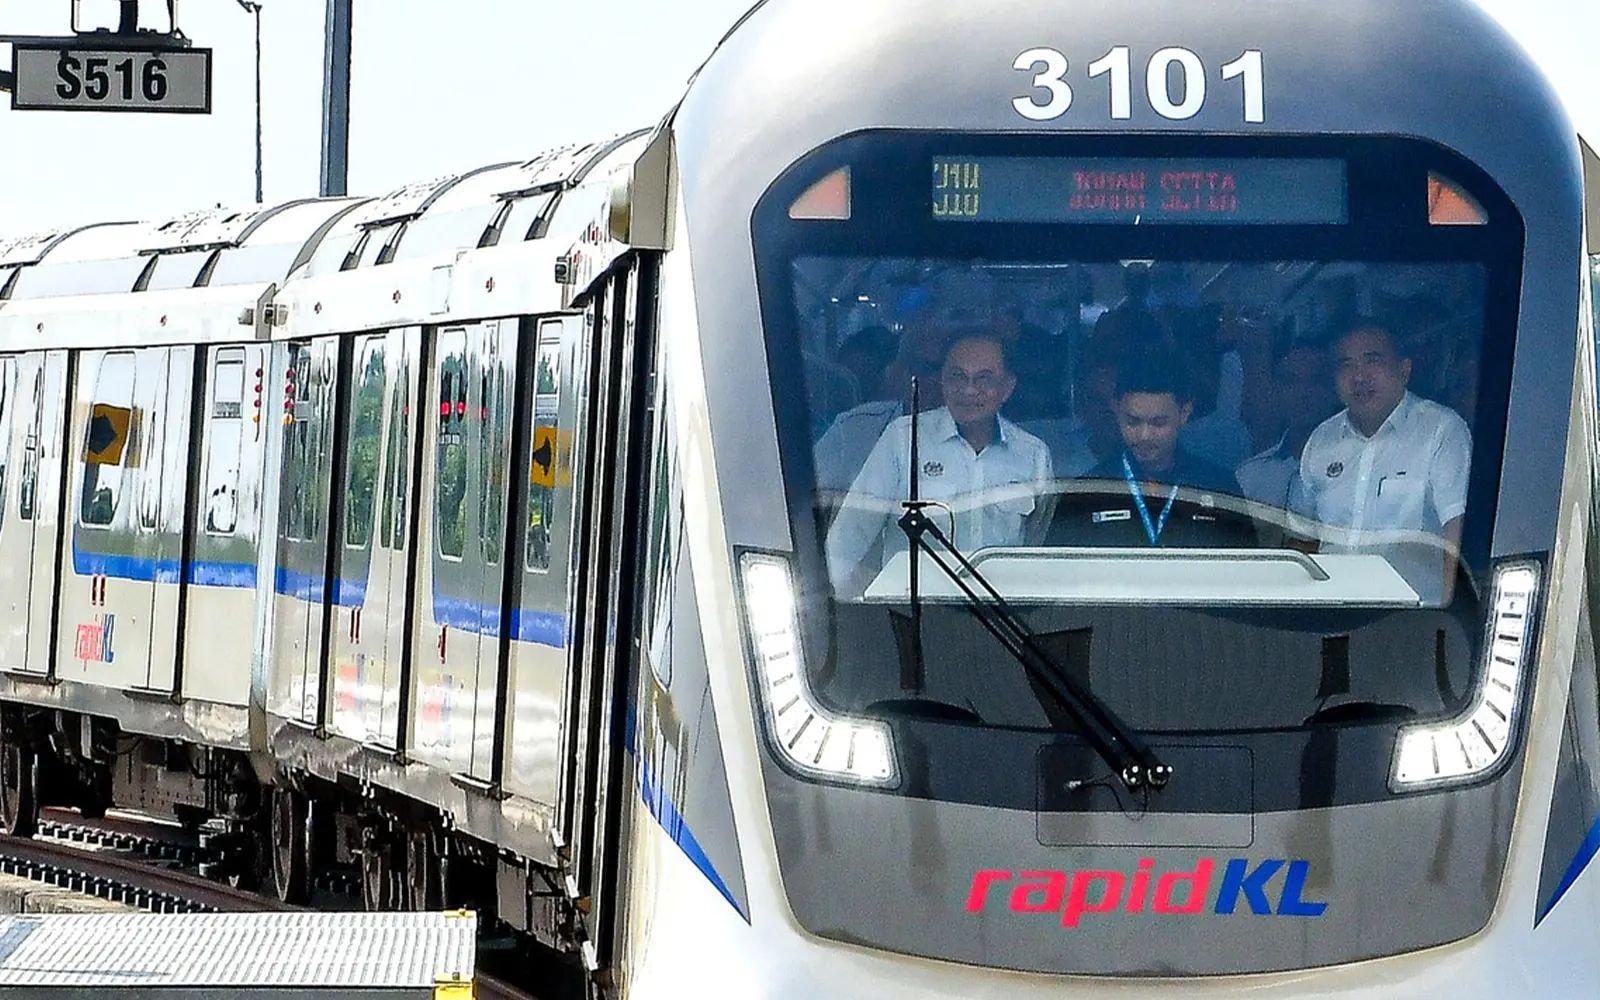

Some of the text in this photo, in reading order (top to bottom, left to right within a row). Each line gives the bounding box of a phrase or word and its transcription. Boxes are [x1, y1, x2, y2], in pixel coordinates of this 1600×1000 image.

[55, 57, 168, 102] S516
[1012, 46, 1265, 123] 3101
[74, 614, 115, 672] rapidKL
[965, 857, 1328, 929] rapidKL
